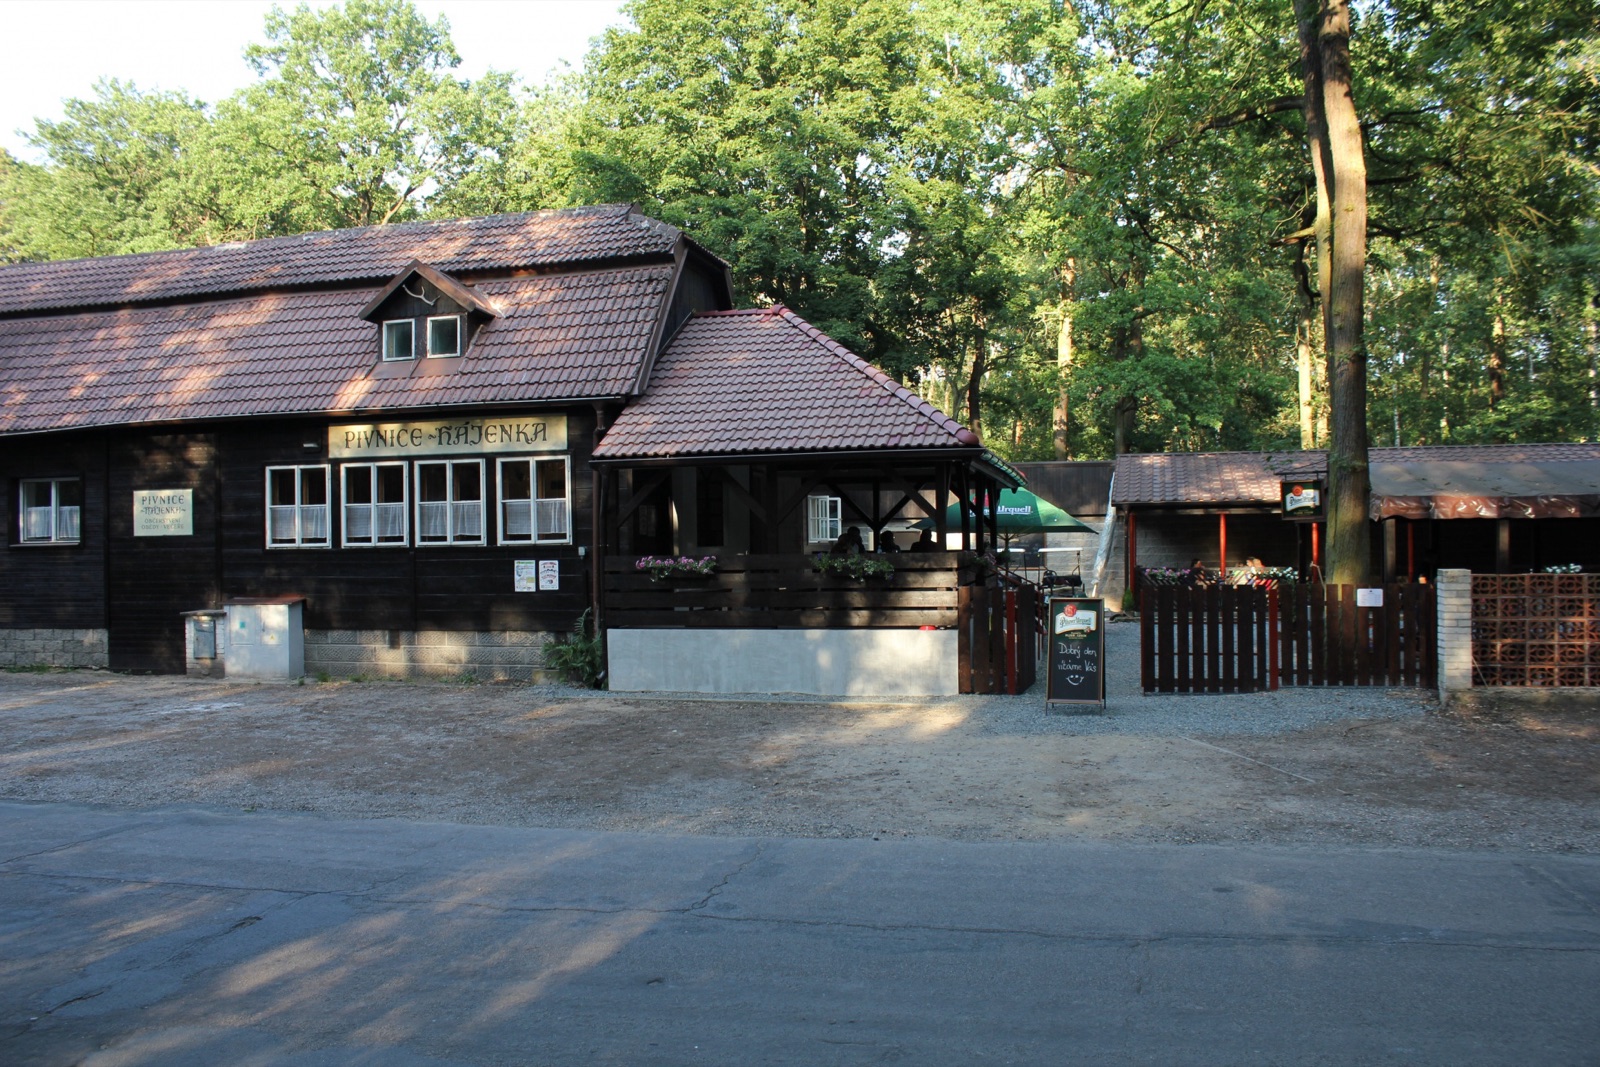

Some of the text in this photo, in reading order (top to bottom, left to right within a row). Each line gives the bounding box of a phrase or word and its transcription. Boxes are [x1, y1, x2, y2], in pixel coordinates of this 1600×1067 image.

[344, 427, 423, 449] PIVNICE
[142, 495, 185, 505] PIVNICE
[996, 505, 1032, 516] Urquell
[1058, 642, 1097, 659] Dobrý den
